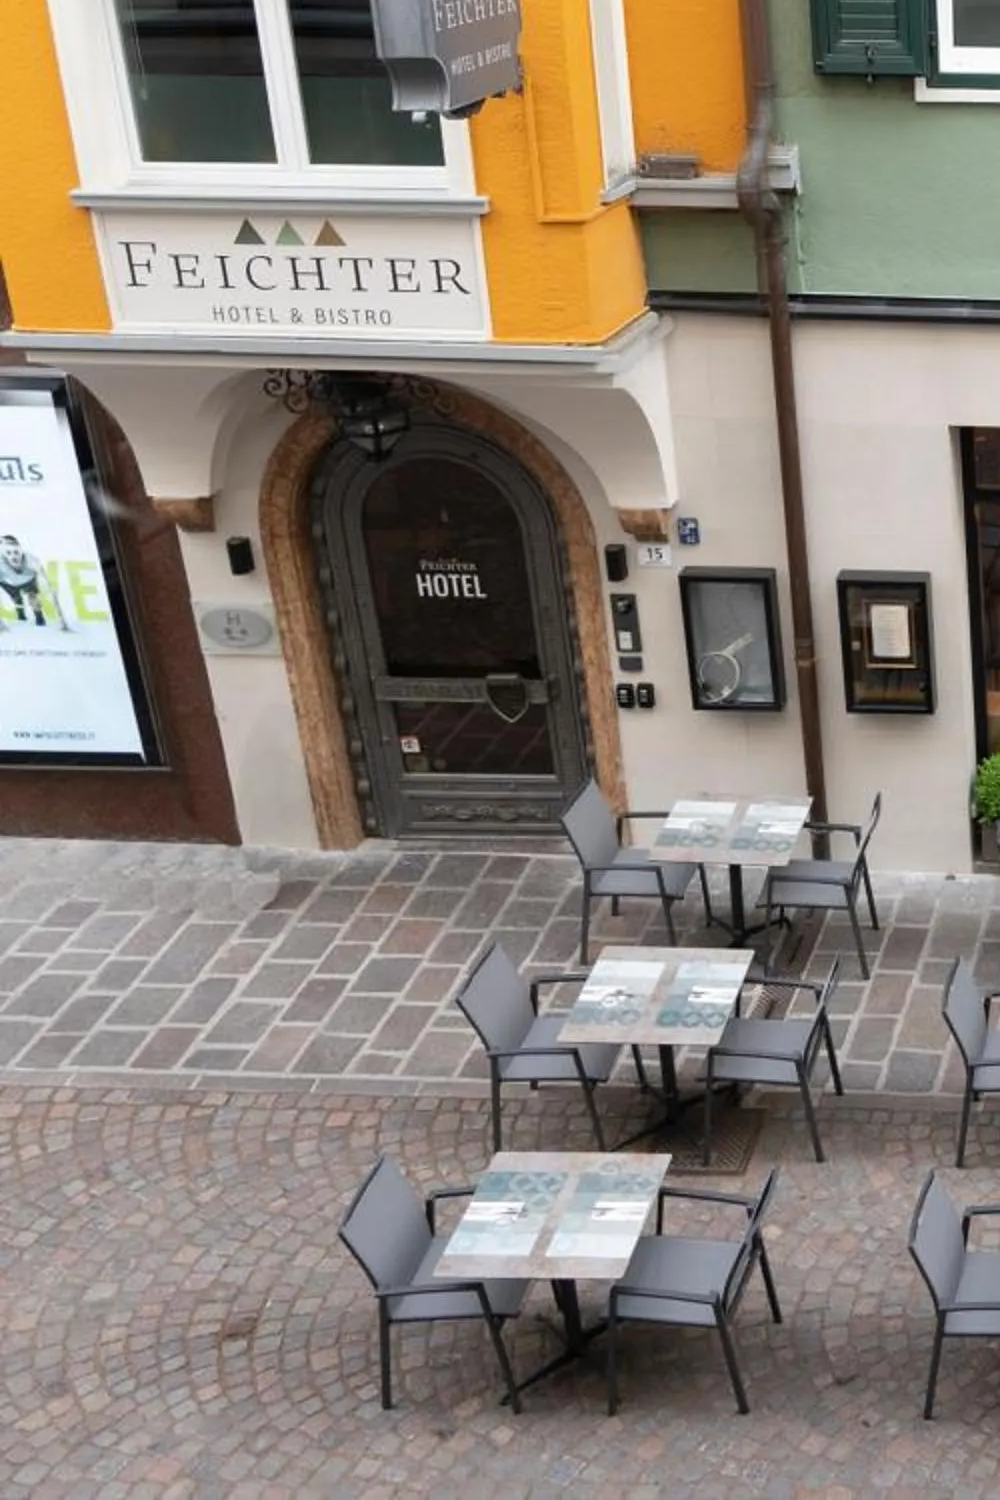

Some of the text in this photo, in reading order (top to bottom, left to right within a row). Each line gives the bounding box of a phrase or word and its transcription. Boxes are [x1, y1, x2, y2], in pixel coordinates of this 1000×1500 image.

[117, 241, 472, 296] FEICHTER
[211, 305, 392, 326] HOTEL & BISTRO
[646, 546, 664, 561] 15
[415, 573, 488, 599] HOTEL
